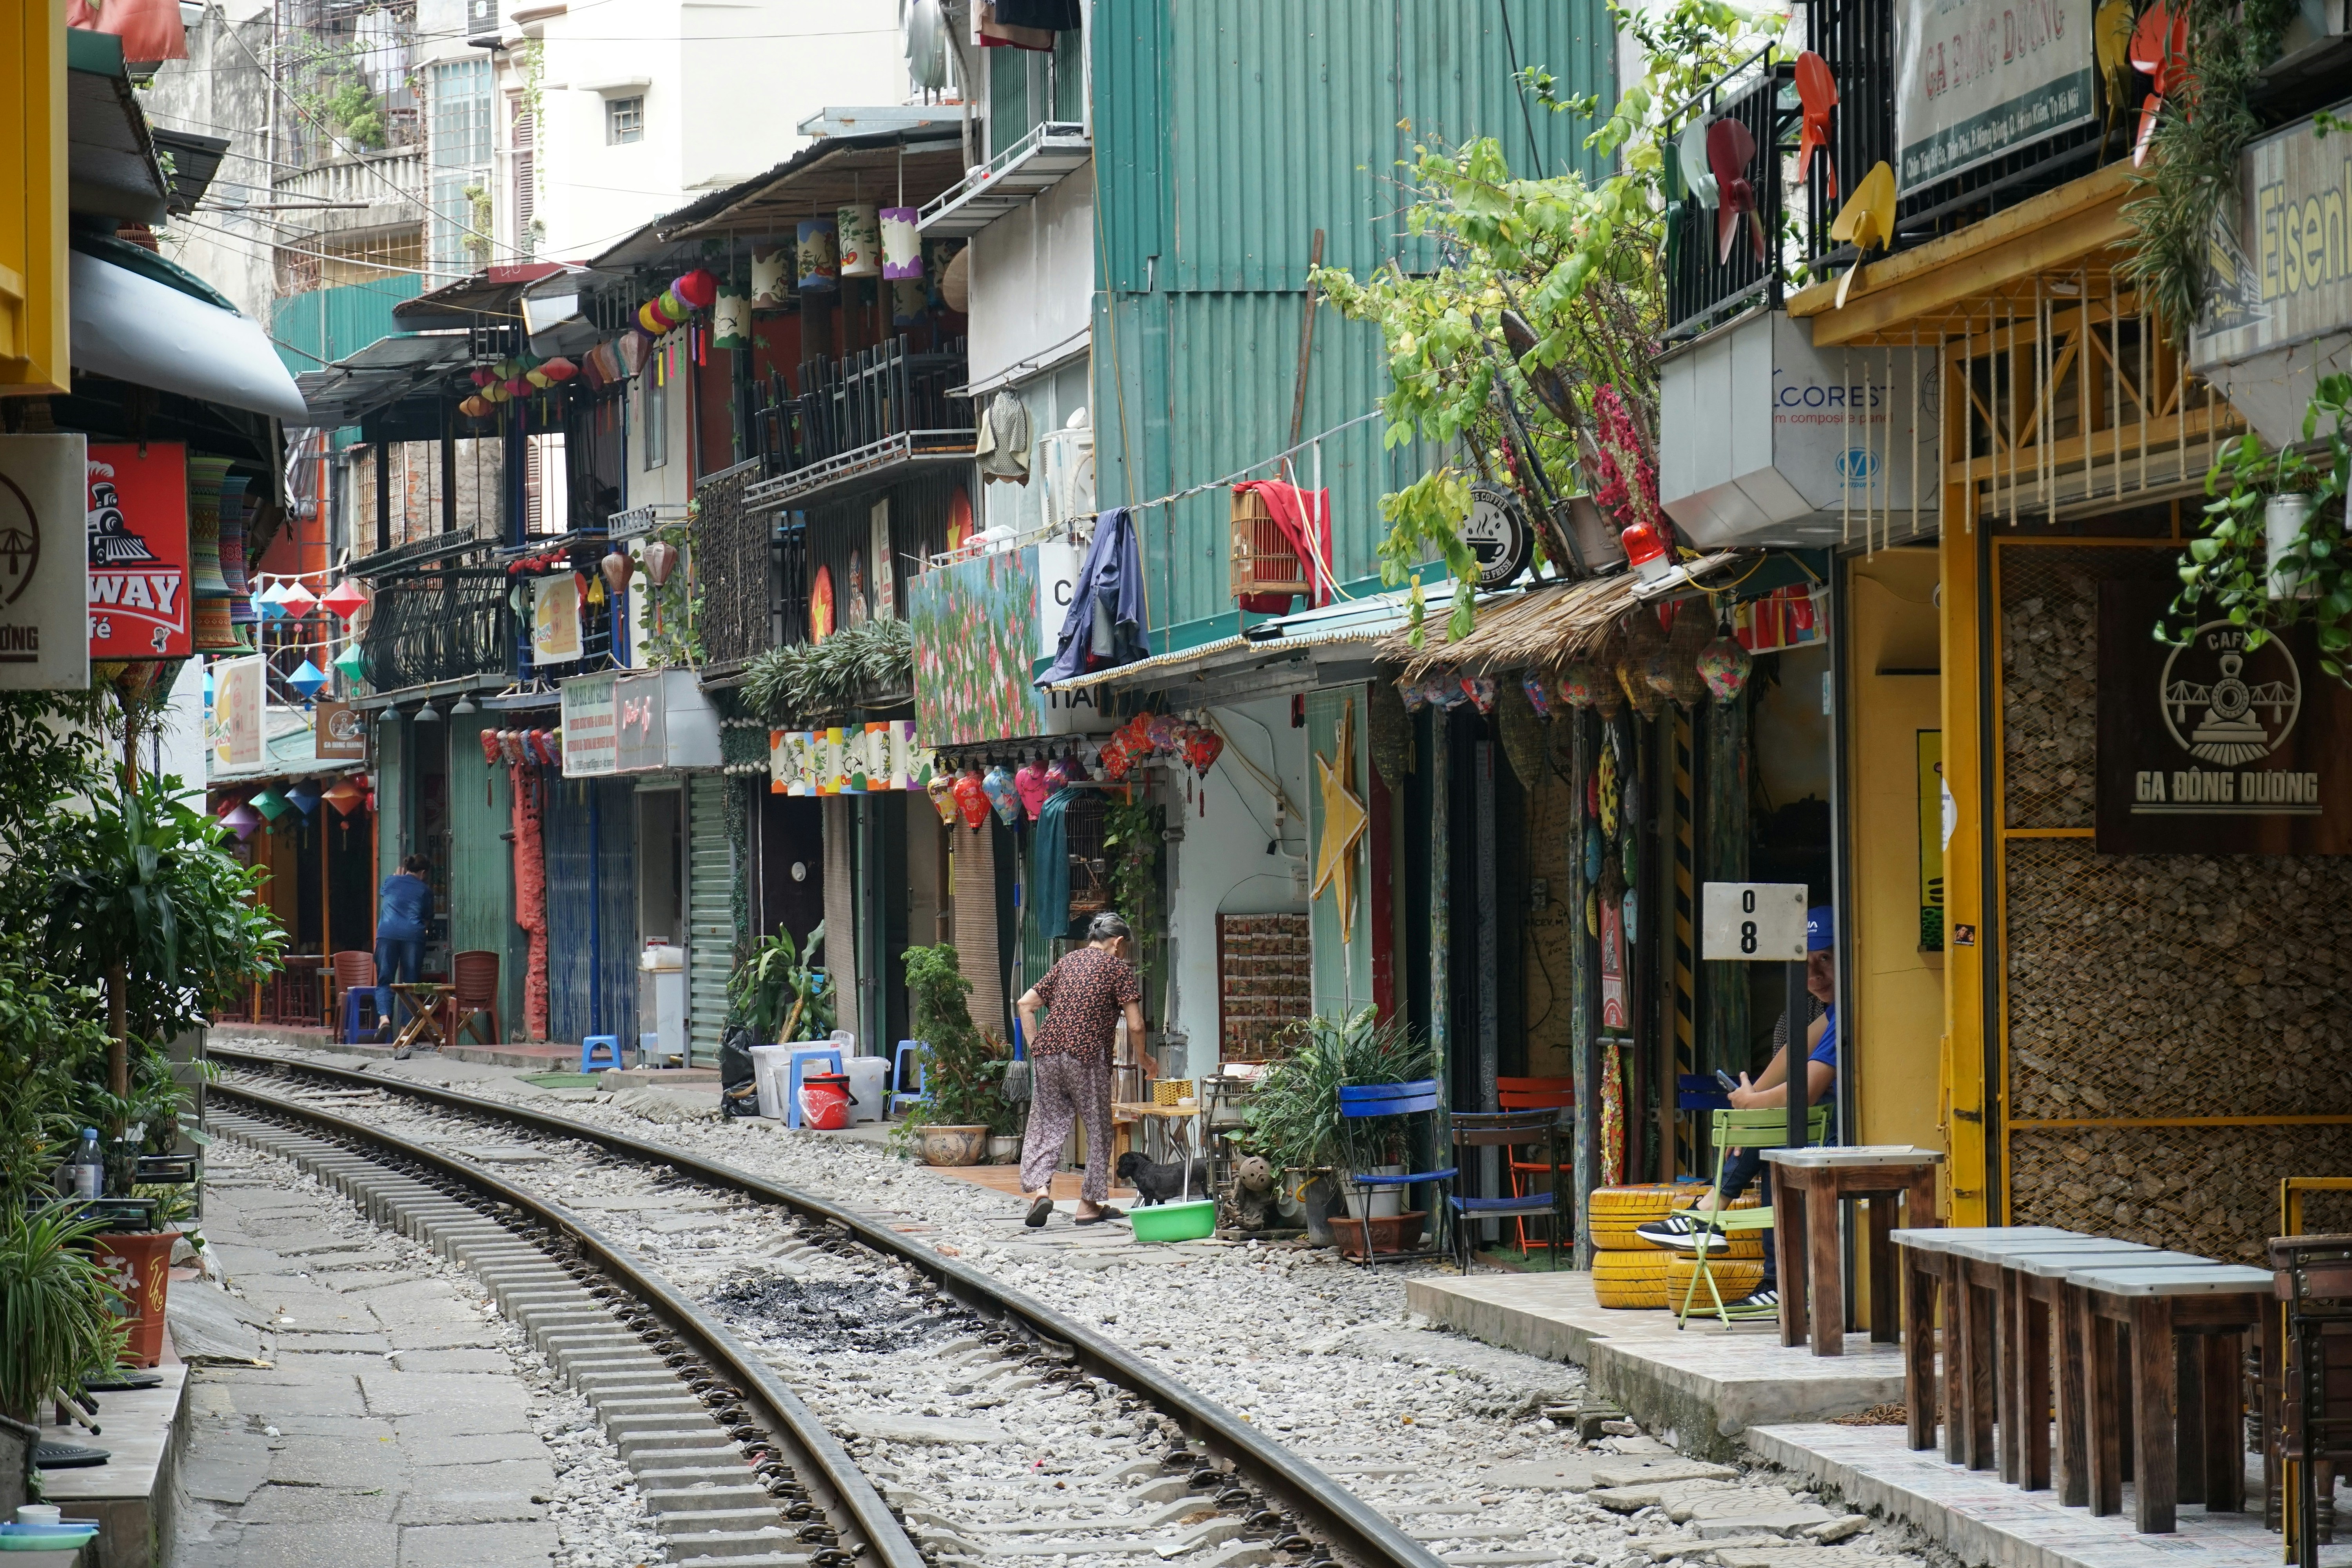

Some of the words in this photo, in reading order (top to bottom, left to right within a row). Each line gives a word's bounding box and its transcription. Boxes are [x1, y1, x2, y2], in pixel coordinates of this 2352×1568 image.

[1791, 412, 1855, 425] composie
[1481, 492, 1508, 511] COFFEE
[1491, 558, 1513, 579] FRESH
[2136, 771, 2166, 802] GA
[2172, 766, 2234, 803] ĐÔNG
[2241, 769, 2318, 803] DƯƠNG
